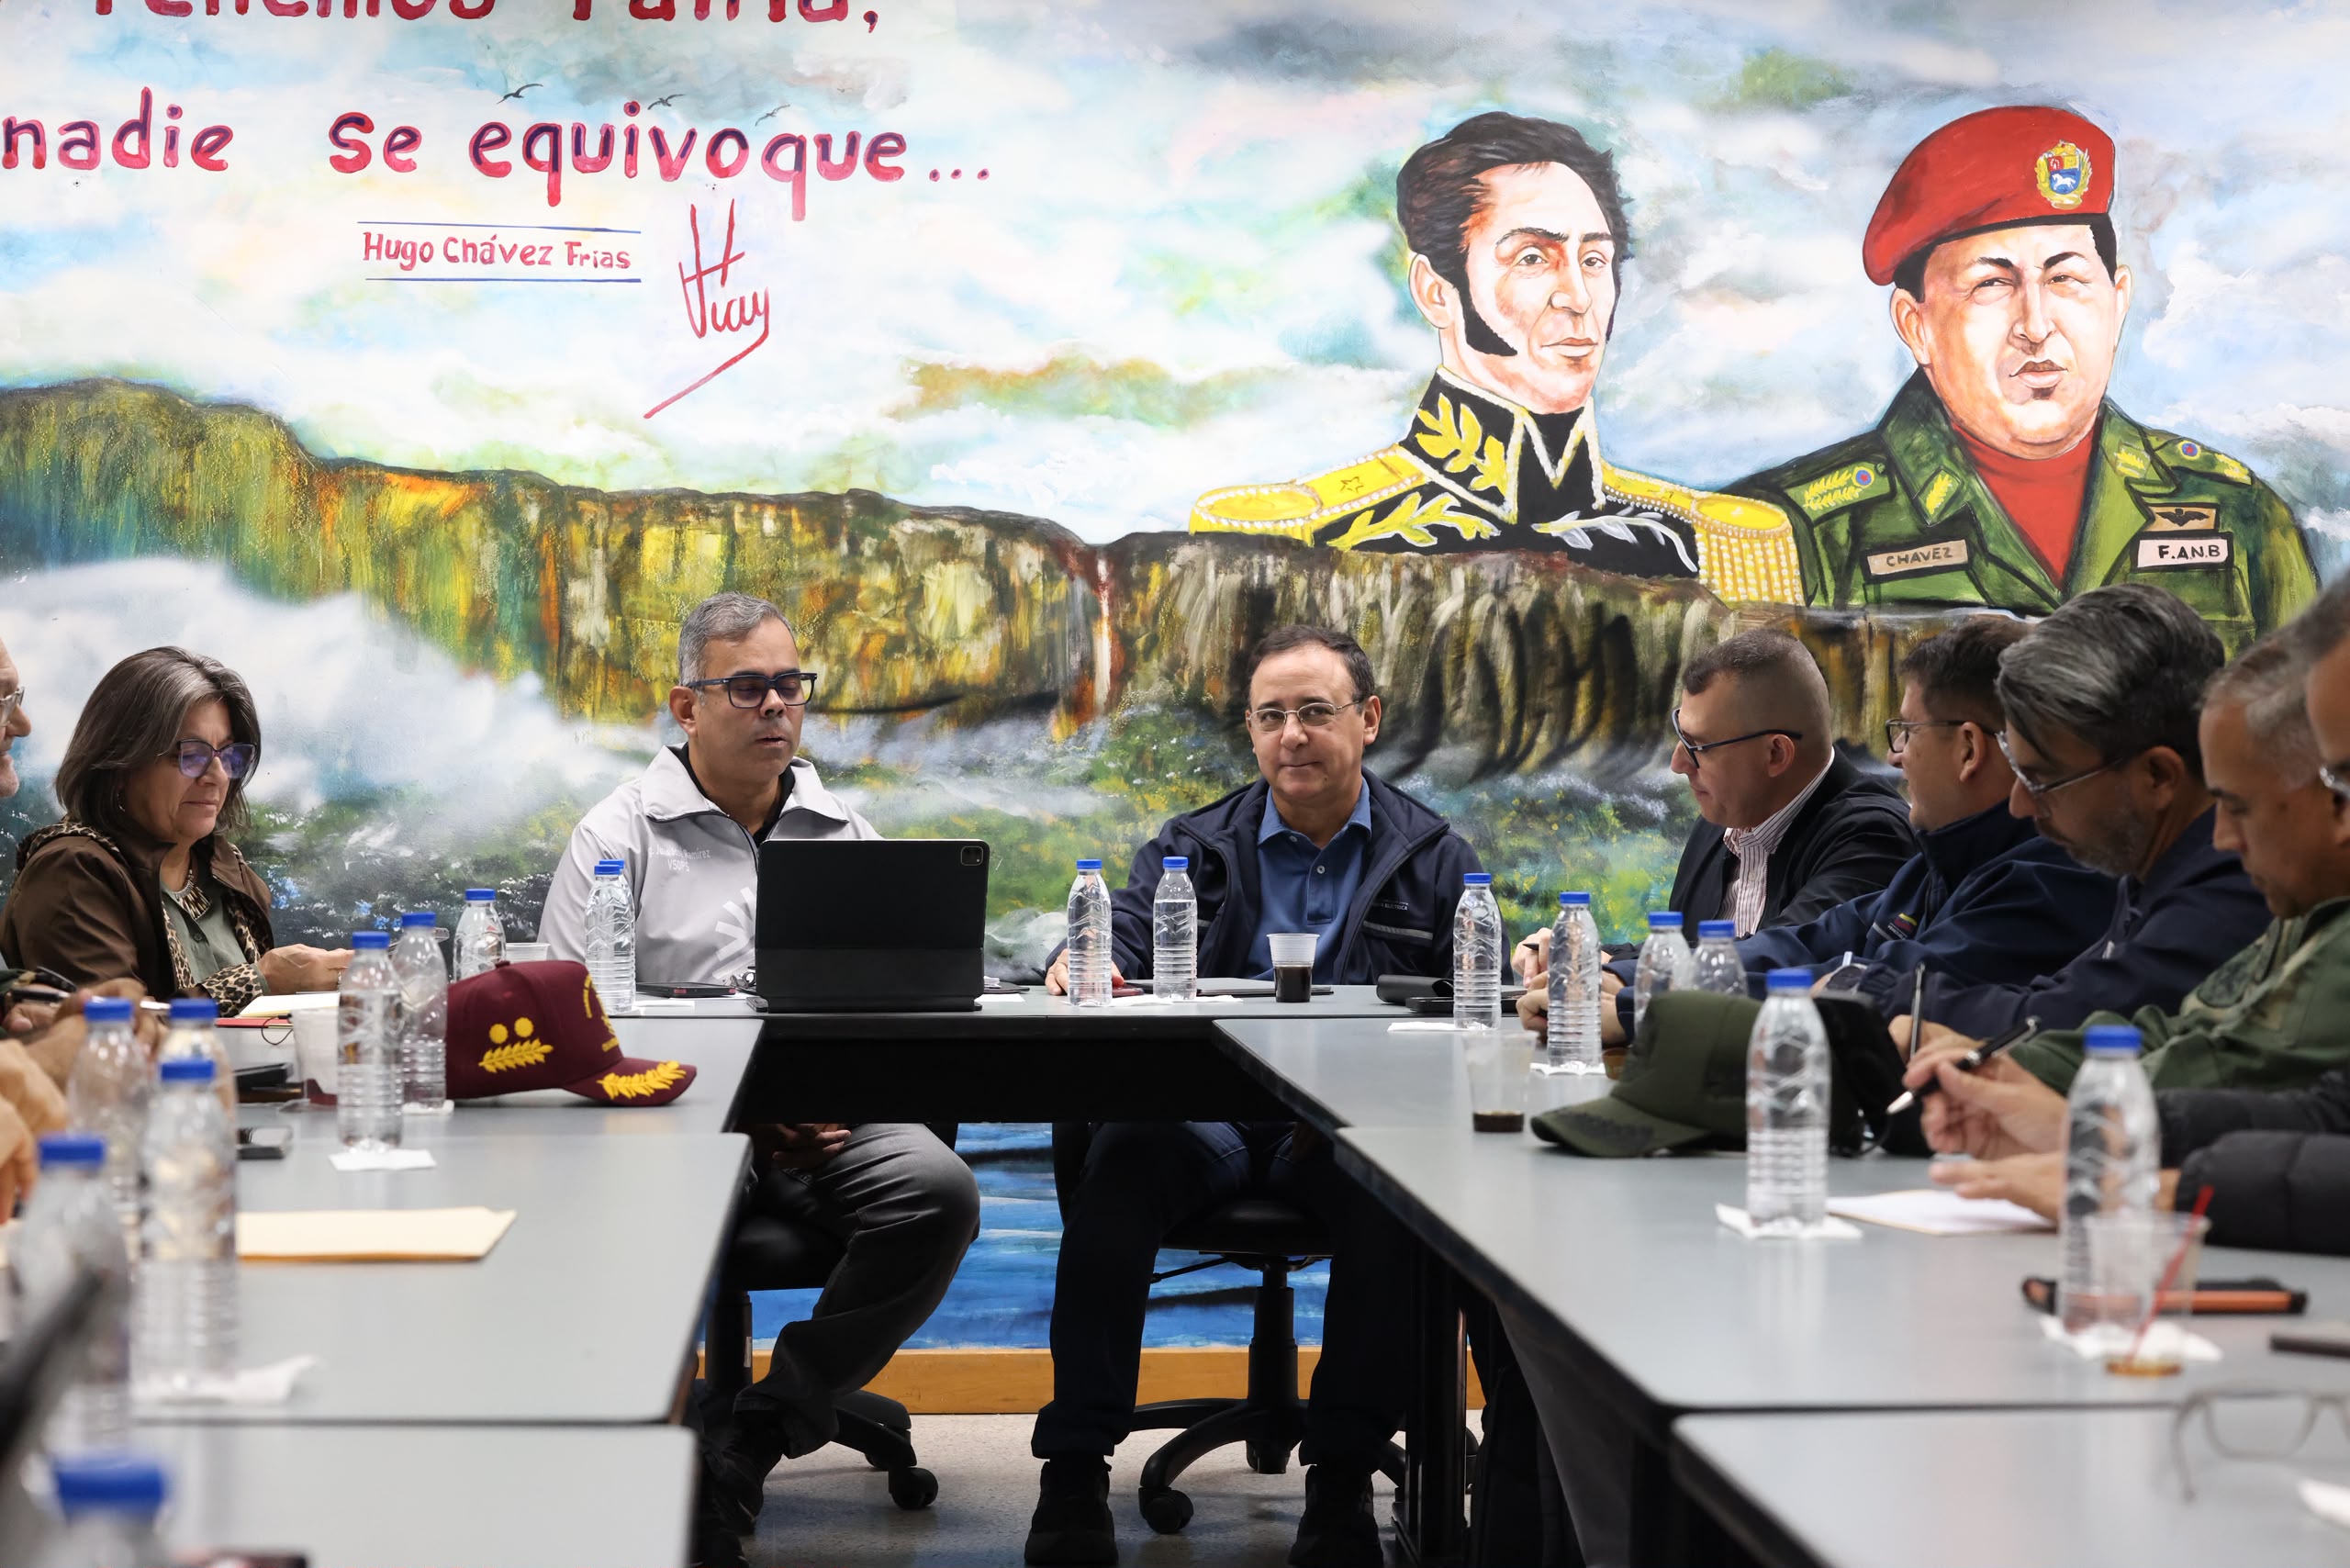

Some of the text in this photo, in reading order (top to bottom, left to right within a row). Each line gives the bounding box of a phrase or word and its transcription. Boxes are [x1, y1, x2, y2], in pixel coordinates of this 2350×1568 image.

[2, 86, 233, 172] nadie
[328, 112, 422, 174] se
[363, 231, 434, 272] Hugo
[442, 233, 554, 266] Chávez
[1886, 547, 1953, 567] CHAVEZ
